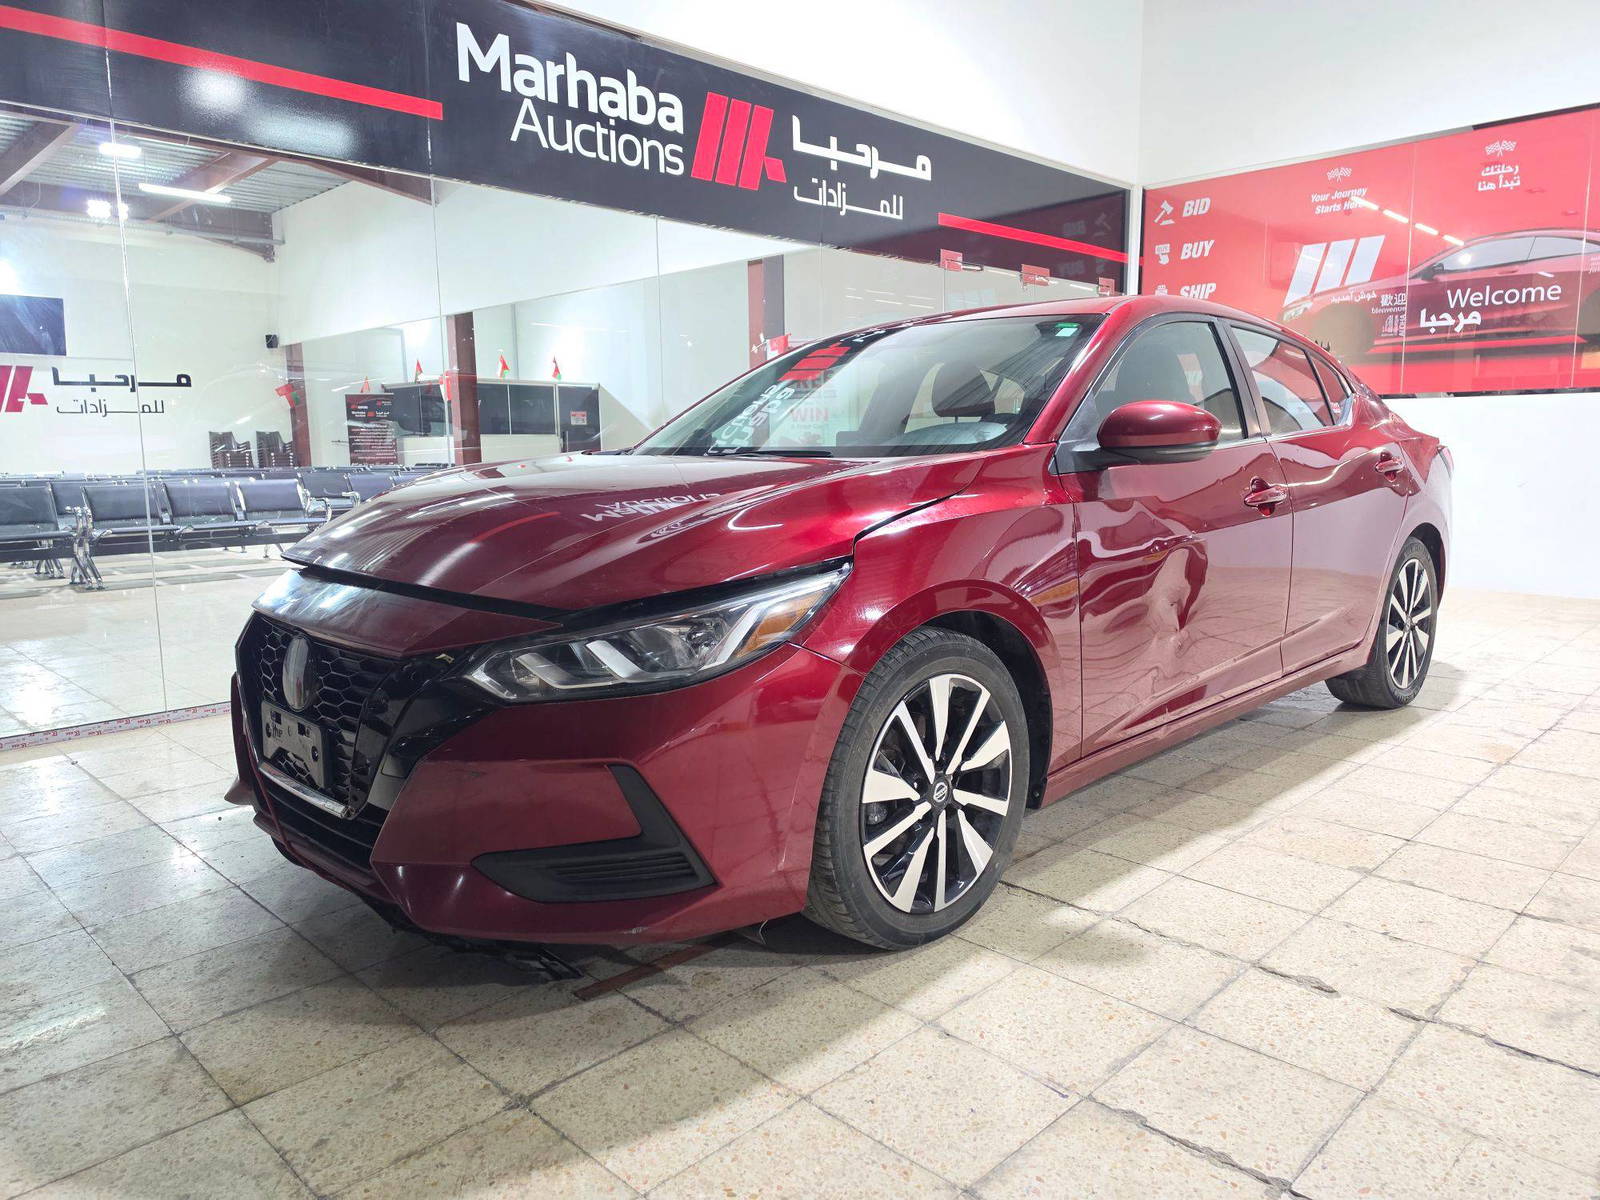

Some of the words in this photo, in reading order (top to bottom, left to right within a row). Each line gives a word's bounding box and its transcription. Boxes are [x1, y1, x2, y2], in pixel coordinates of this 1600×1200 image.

[456, 22, 684, 134] Marhaba
[510, 98, 684, 176] Auctions
[792, 114, 932, 181] مرحبا
[1481, 164, 1519, 176] رحلتك
[1311, 192, 1330, 203] Your
[1331, 187, 1367, 200] Journey
[1478, 181, 1496, 191] هنا
[793, 176, 903, 220] للمزادات
[1182, 197, 1211, 217] BID
[1315, 203, 1342, 214] Starts
[1180, 239, 1216, 260] BUY
[1180, 283, 1217, 300] SHIP
[1447, 284, 1562, 309] Welcome
[1420, 308, 1482, 333] مرحبا
[52, 366, 192, 393] مرحبا
[56, 399, 165, 417] للمزادات
